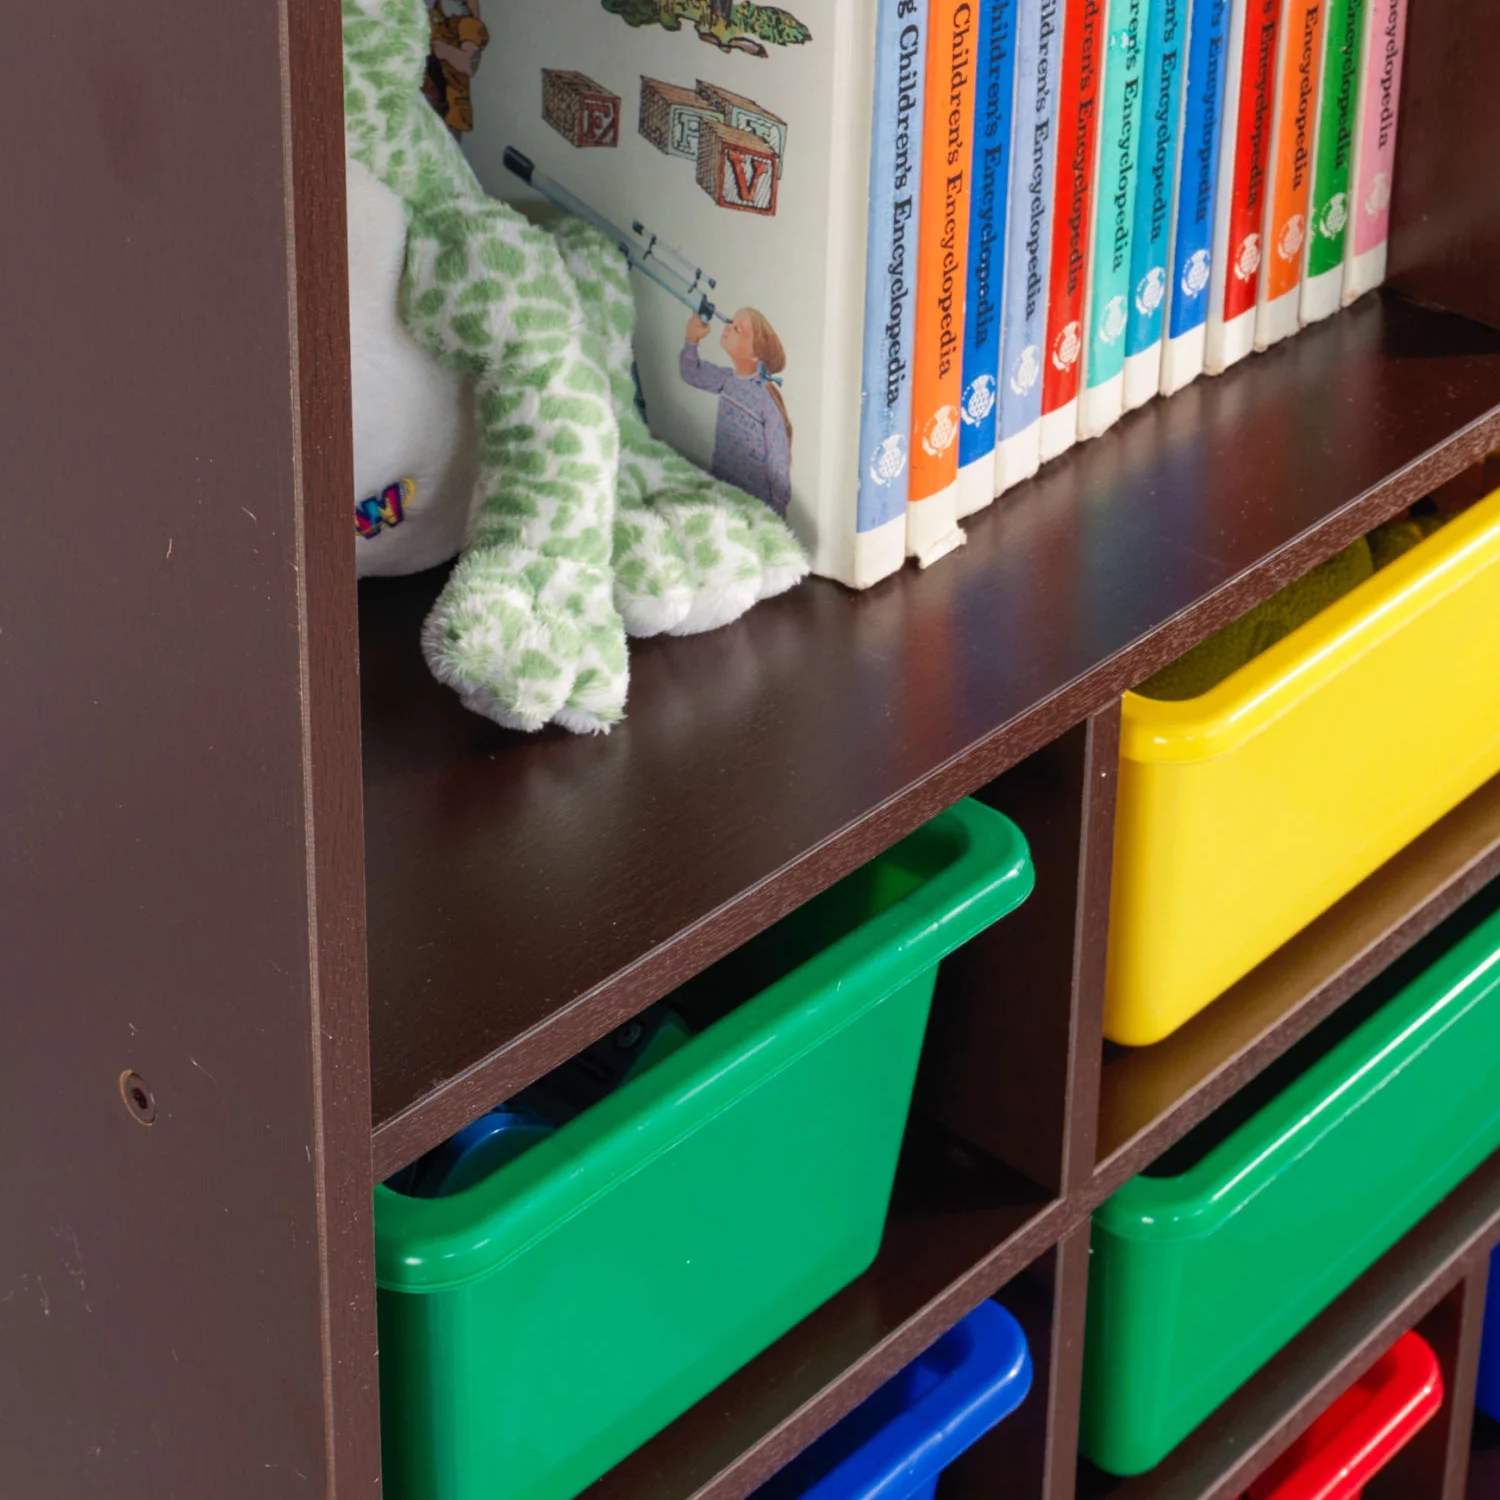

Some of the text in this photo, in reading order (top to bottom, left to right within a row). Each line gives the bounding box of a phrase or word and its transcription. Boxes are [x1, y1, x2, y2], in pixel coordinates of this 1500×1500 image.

[727, 149, 767, 202] V
[893, 24, 919, 190] Children's
[947, 3, 972, 165] Children's
[1113, 76, 1139, 274] Encyclopedia
[1151, 50, 1177, 244] Encyclopedia
[1196, 36, 1222, 224] Encyclopedia
[1247, 22, 1275, 209] Encyclopedia
[1293, 4, 1319, 191] Encyclopedia
[938, 170, 963, 380] Encyclopedia
[975, 143, 1001, 348] Encyclopedia
[1025, 117, 1050, 322] Encyclopedia
[1067, 98, 1093, 296] Encyclopedia
[886, 195, 913, 408] Encyclopedia
